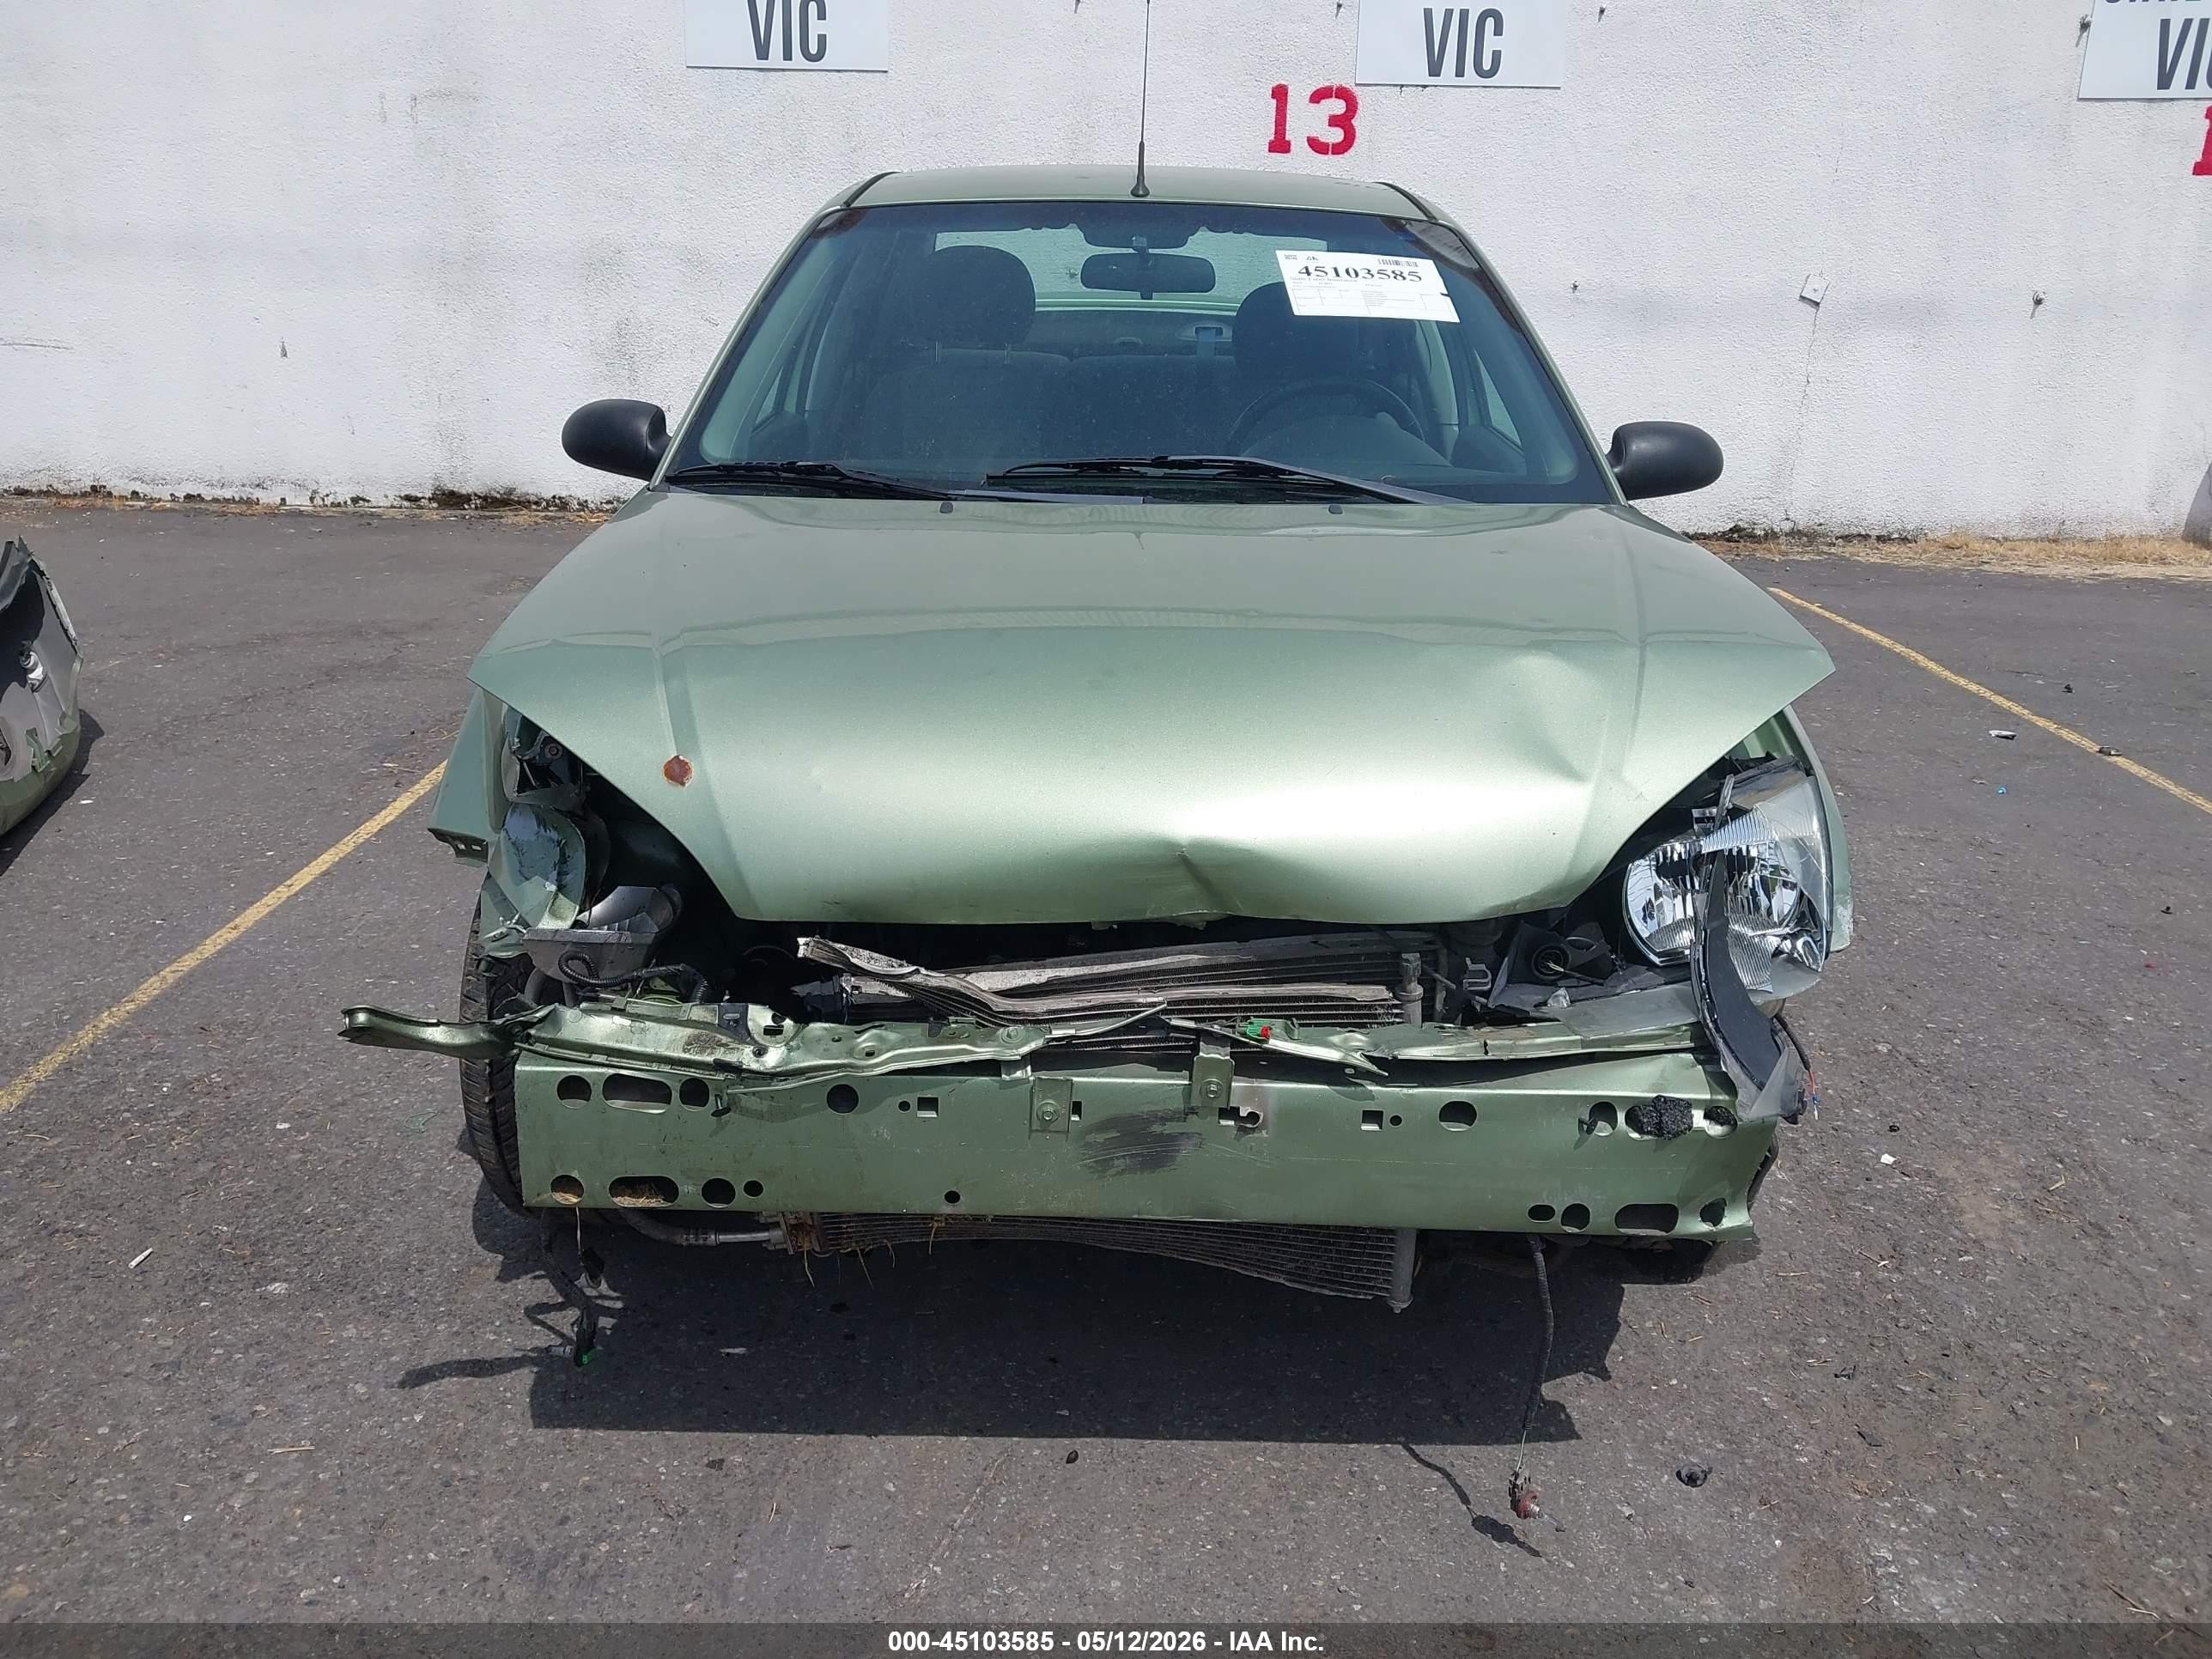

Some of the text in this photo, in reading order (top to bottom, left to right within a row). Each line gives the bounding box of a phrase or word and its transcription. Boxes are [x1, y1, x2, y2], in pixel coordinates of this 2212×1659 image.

[747, 0, 827, 63] VIC
[1423, 7, 1504, 79] VIC
[2157, 18, 2212, 90] VI
[1267, 83, 1359, 155] 13
[1297, 265, 1422, 283] 45103585
